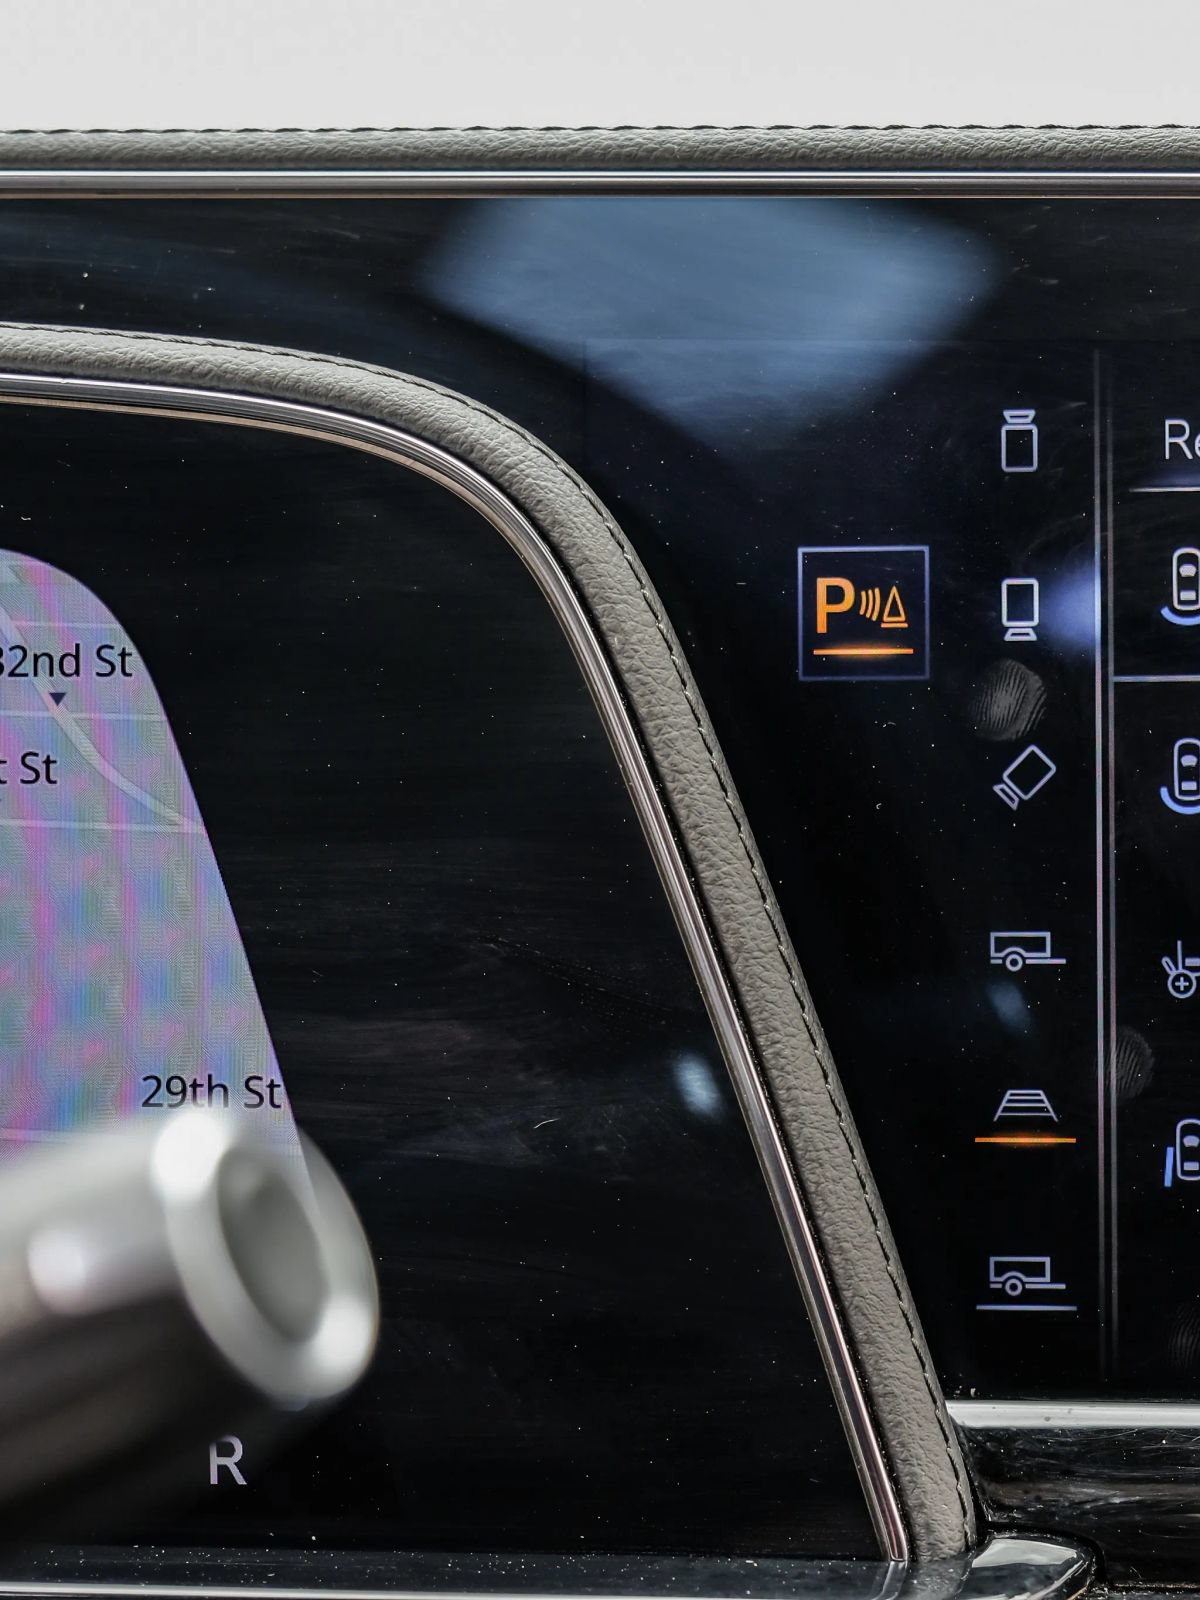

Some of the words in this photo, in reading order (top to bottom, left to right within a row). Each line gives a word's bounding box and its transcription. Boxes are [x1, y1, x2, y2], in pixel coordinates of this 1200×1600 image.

[0, 643, 81, 678] 2nd
[95, 644, 133, 678] St
[19, 751, 58, 785] St
[141, 1073, 229, 1109] 29th
[243, 1074, 282, 1109] St
[208, 1436, 248, 1485] R
